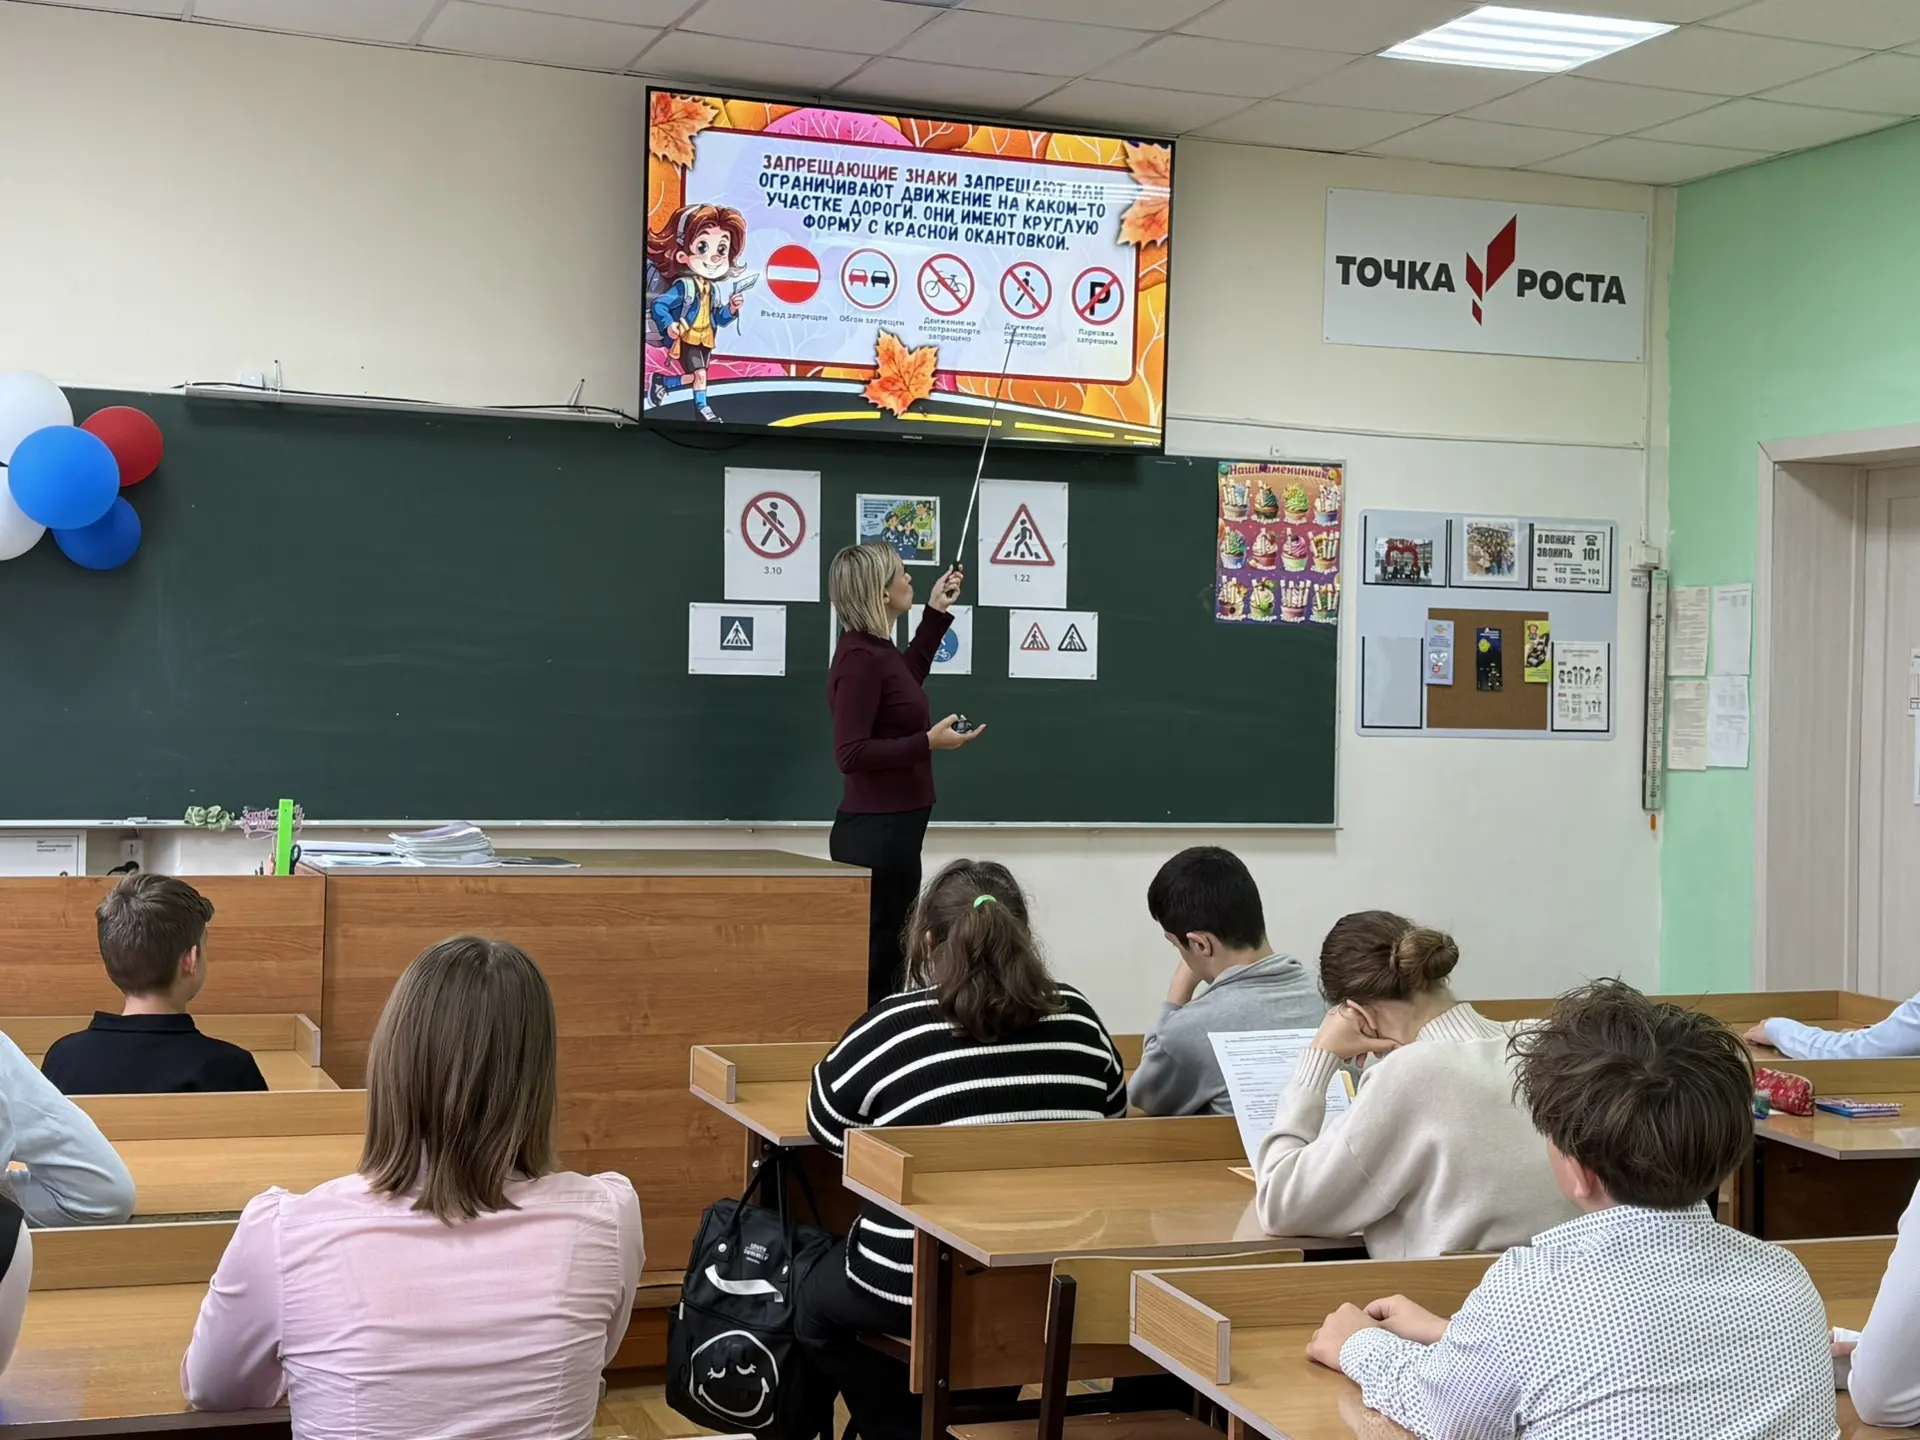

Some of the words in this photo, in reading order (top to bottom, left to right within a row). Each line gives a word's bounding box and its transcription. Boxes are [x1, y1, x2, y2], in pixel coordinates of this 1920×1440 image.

[763, 155, 899, 183] ЗАПРЕЩАЮЩИЕ
[905, 168, 958, 187] ЗНАКИ
[759, 172, 894, 199] ОГРАНИЧИВАЮТ
[901, 186, 992, 208] ДВИЖЕНИЕ
[998, 195, 1019, 211] НА
[1026, 198, 1106, 218] КАКОМ-ТО
[766, 191, 843, 213] УЧАСТКЕ
[849, 199, 918, 220] ДОРОГИ.
[924, 206, 955, 224] ОНИ
[961, 209, 1017, 228] ИМЕЮТ
[1023, 215, 1099, 235] КРУГЛУЮ
[803, 213, 862, 233] ФОРМУ
[868, 219, 878, 235] С
[884, 220, 959, 242] КРАСНОЙ
[965, 228, 1070, 251] ОКАНТОВКОЙ.
[1335, 255, 1456, 293] ТОЧКА
[1517, 268, 1627, 305] РОСТА
[760, 309, 786, 319] Въезд
[787, 312, 828, 323] запрещен
[839, 315, 864, 324] Обгон
[865, 318, 905, 328] запрещен
[924, 316, 965, 326] Движение
[918, 325, 981, 336] велотранспорте
[1078, 328, 1115, 337] Парковка
[928, 333, 972, 342] запрещено
[1537, 533, 1543, 544] О
[1544, 534, 1576, 546] ПОЖАРЕ
[1536, 547, 1573, 559] ЗВОНИТЬ
[1582, 547, 1601, 561] 101
[763, 566, 782, 576] 3.10
[1013, 573, 1031, 583] 1.22
